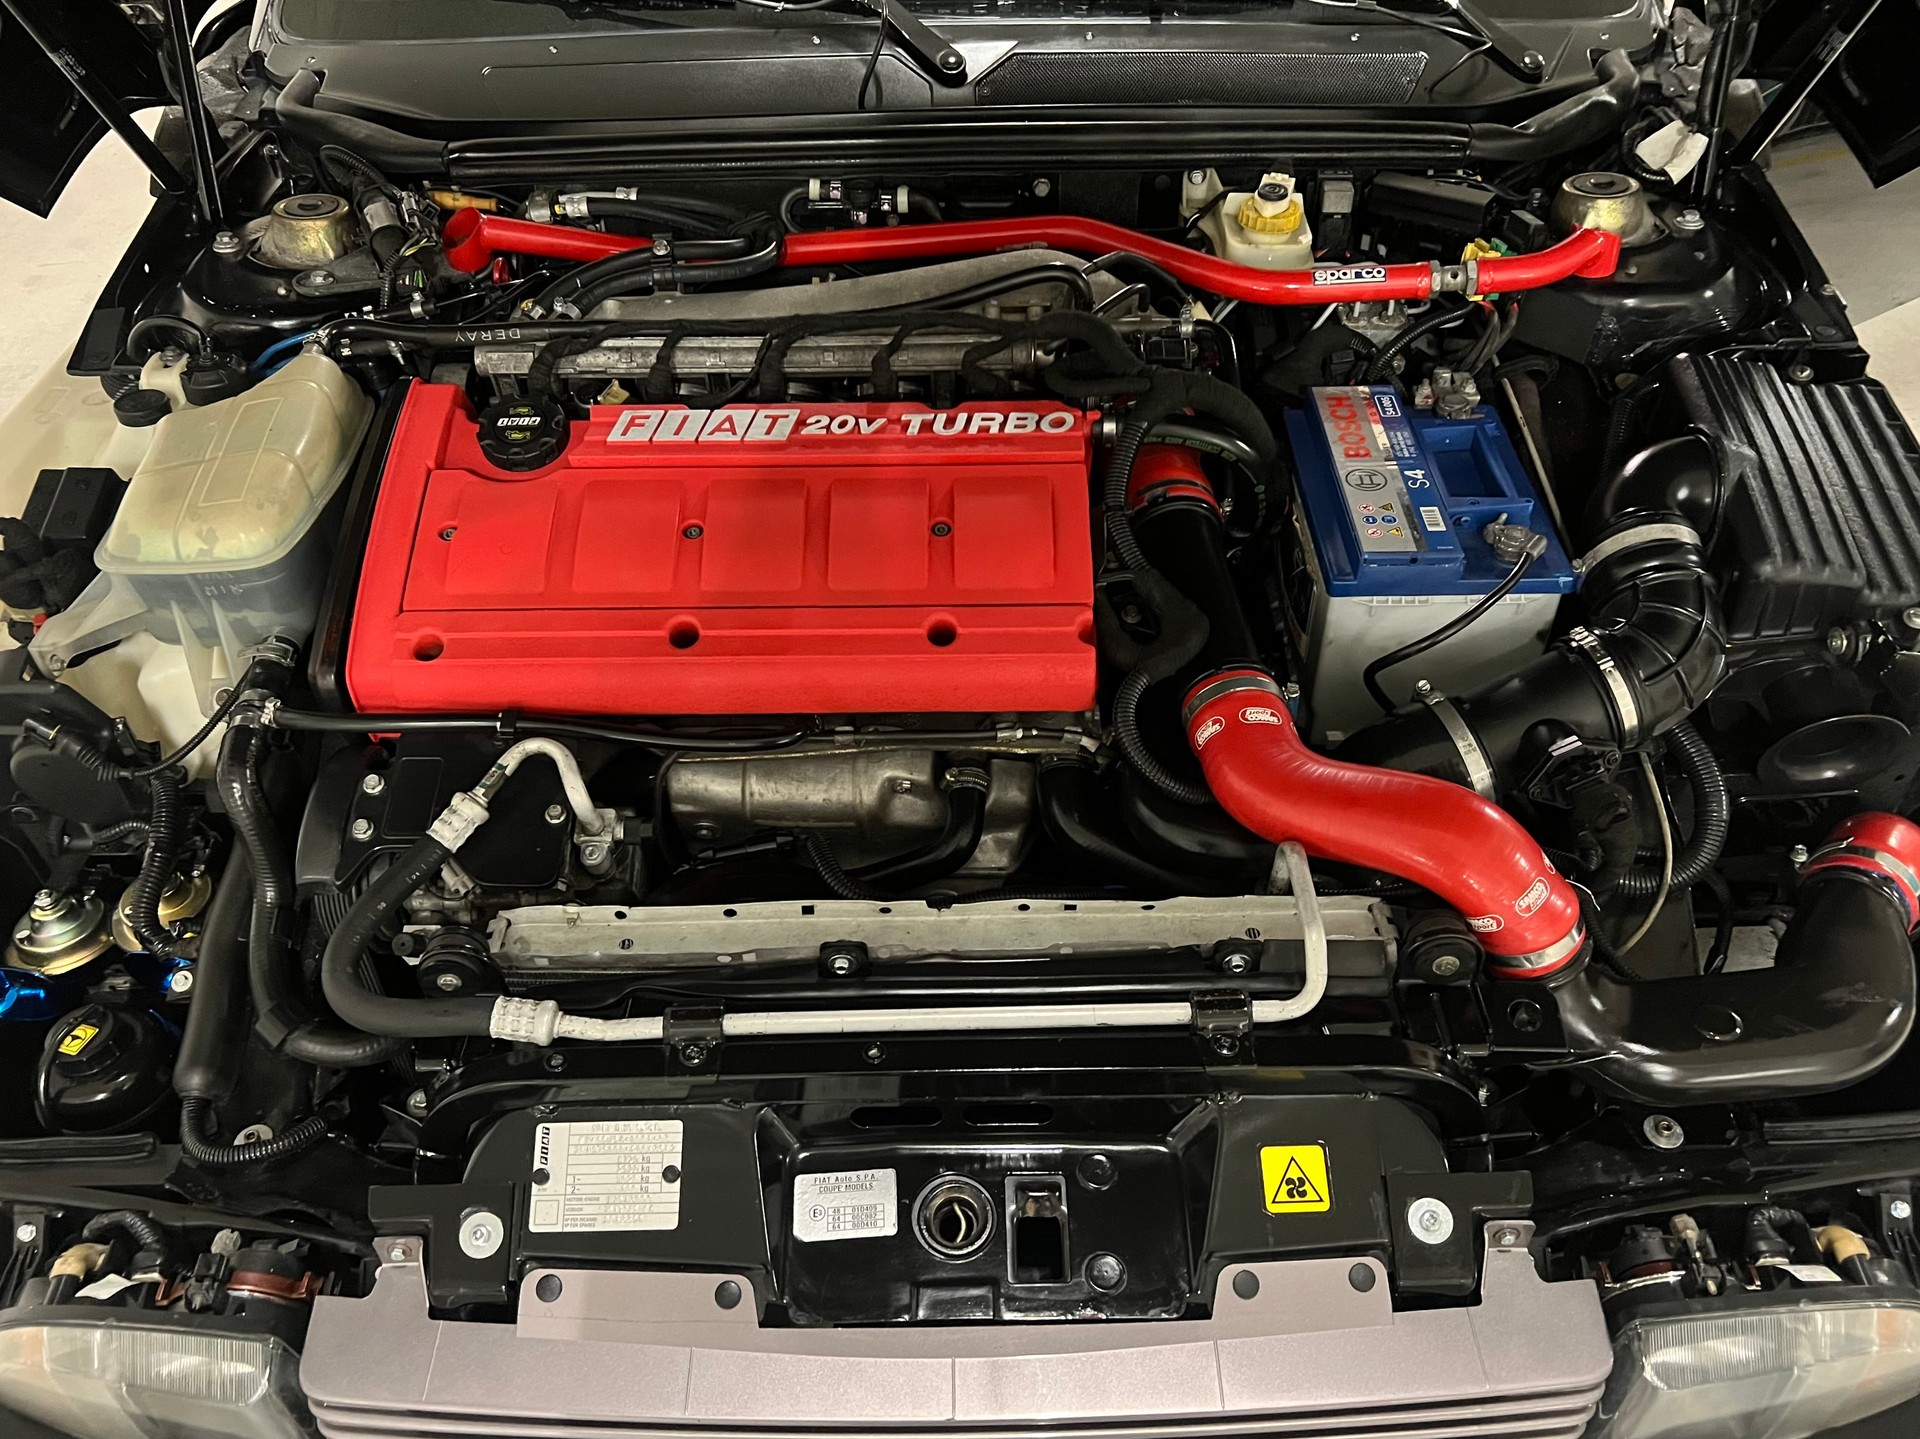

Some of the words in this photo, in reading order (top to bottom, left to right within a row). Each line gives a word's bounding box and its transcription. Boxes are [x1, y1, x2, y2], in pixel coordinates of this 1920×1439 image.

[1314, 268, 1386, 285] sparco
[455, 328, 521, 342] DERAY
[497, 417, 541, 427] FIAT
[617, 413, 793, 438] FIAT
[901, 411, 1075, 436] TURBO
[1325, 395, 1371, 458] BOSCH
[1403, 469, 1430, 489] S4
[1518, 881, 1543, 909] SAMCO
[540, 1126, 550, 1165] FIAT
[814, 1177, 831, 1185] FIAT
[845, 1182, 874, 1191] MODELS
